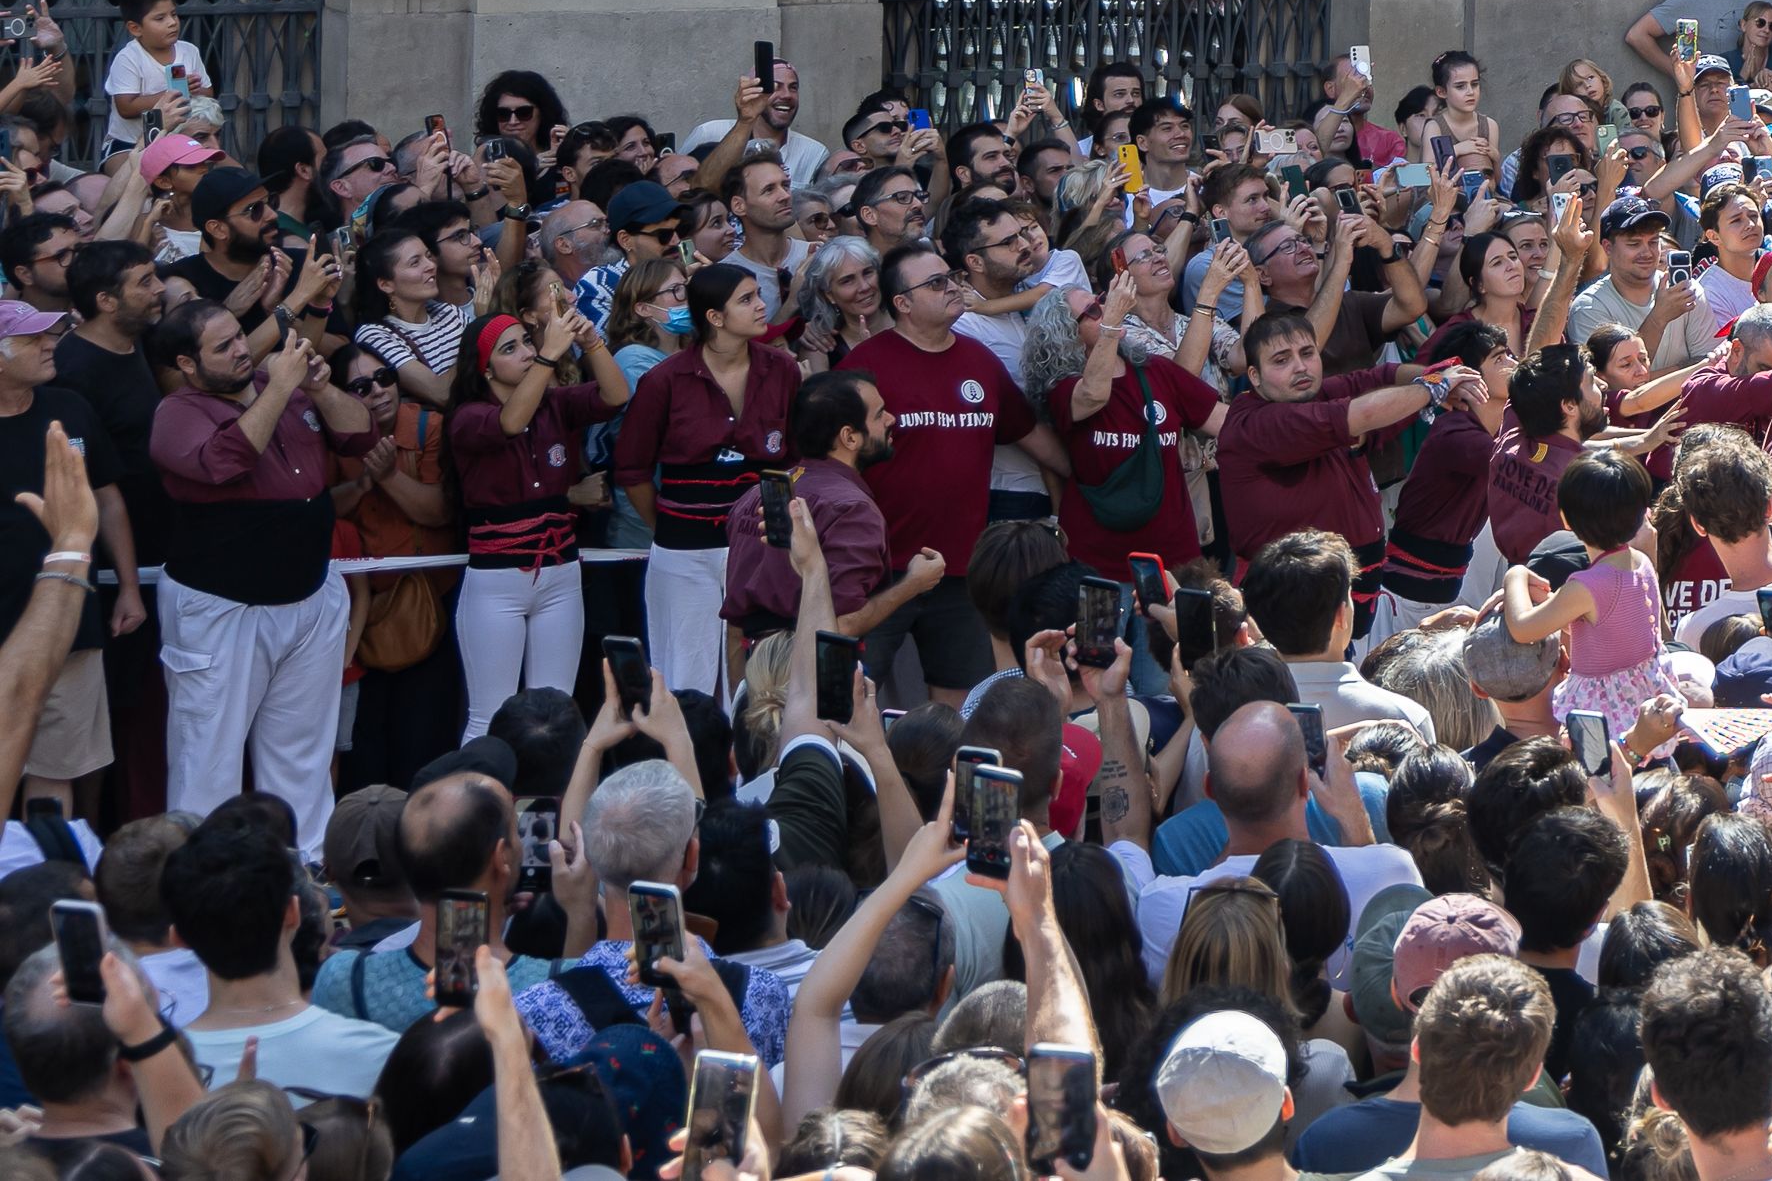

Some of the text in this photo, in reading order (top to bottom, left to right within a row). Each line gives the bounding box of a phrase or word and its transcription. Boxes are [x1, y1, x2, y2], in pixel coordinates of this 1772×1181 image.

[899, 411, 994, 428] JUNTS FEM PINYA
[1122, 432, 1140, 448] FEM
[1158, 431, 1177, 447] NYA
[1498, 456, 1534, 487] JOVE
[1493, 474, 1550, 516] BARCELONA
